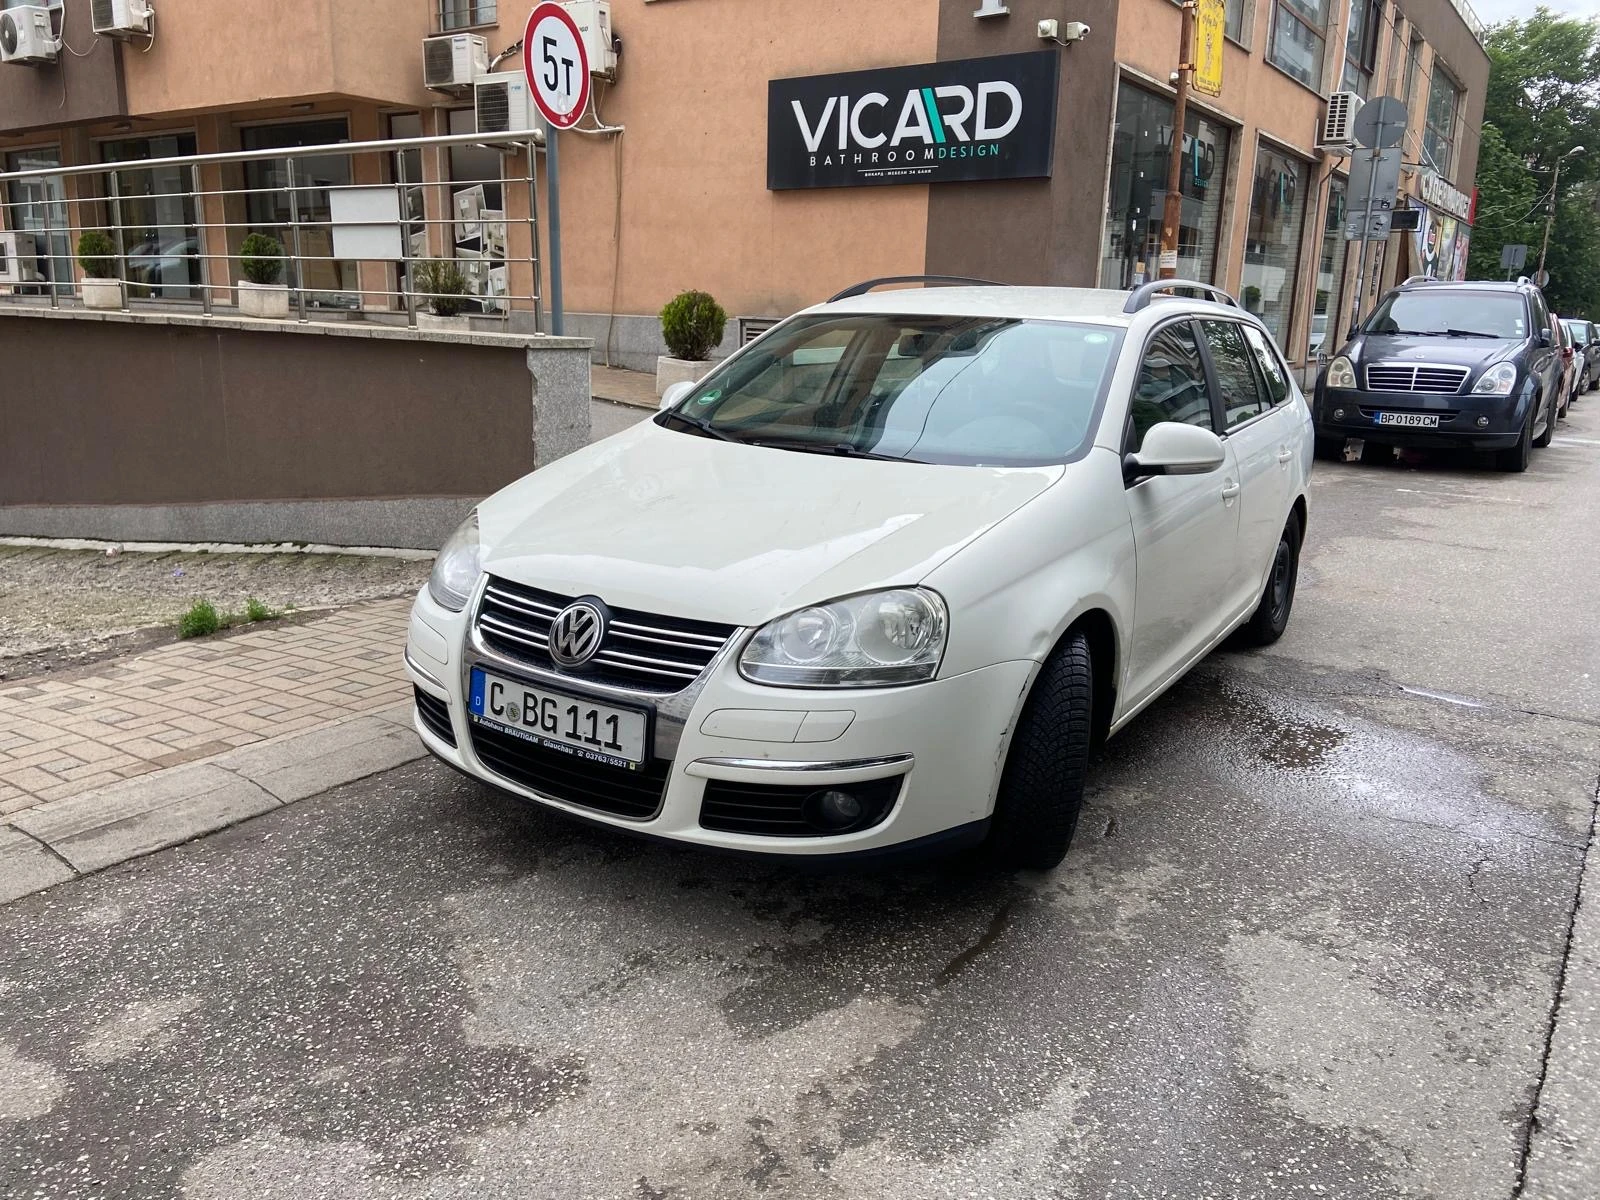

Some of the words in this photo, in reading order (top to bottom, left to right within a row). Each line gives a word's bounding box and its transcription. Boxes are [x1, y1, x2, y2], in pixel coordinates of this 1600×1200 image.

[790, 80, 1023, 153] VICARD
[809, 148, 934, 167] BATHROOM
[938, 144, 1000, 159] DESIGN
[1380, 413, 1395, 424] BP
[1396, 414, 1422, 426] 0189
[1422, 416, 1438, 427] CM
[490, 681, 505, 716] C
[522, 691, 558, 734] BG
[565, 704, 623, 752] 111
[479, 717, 504, 733] Autohaus
[543, 739, 574, 755] Glauchau
